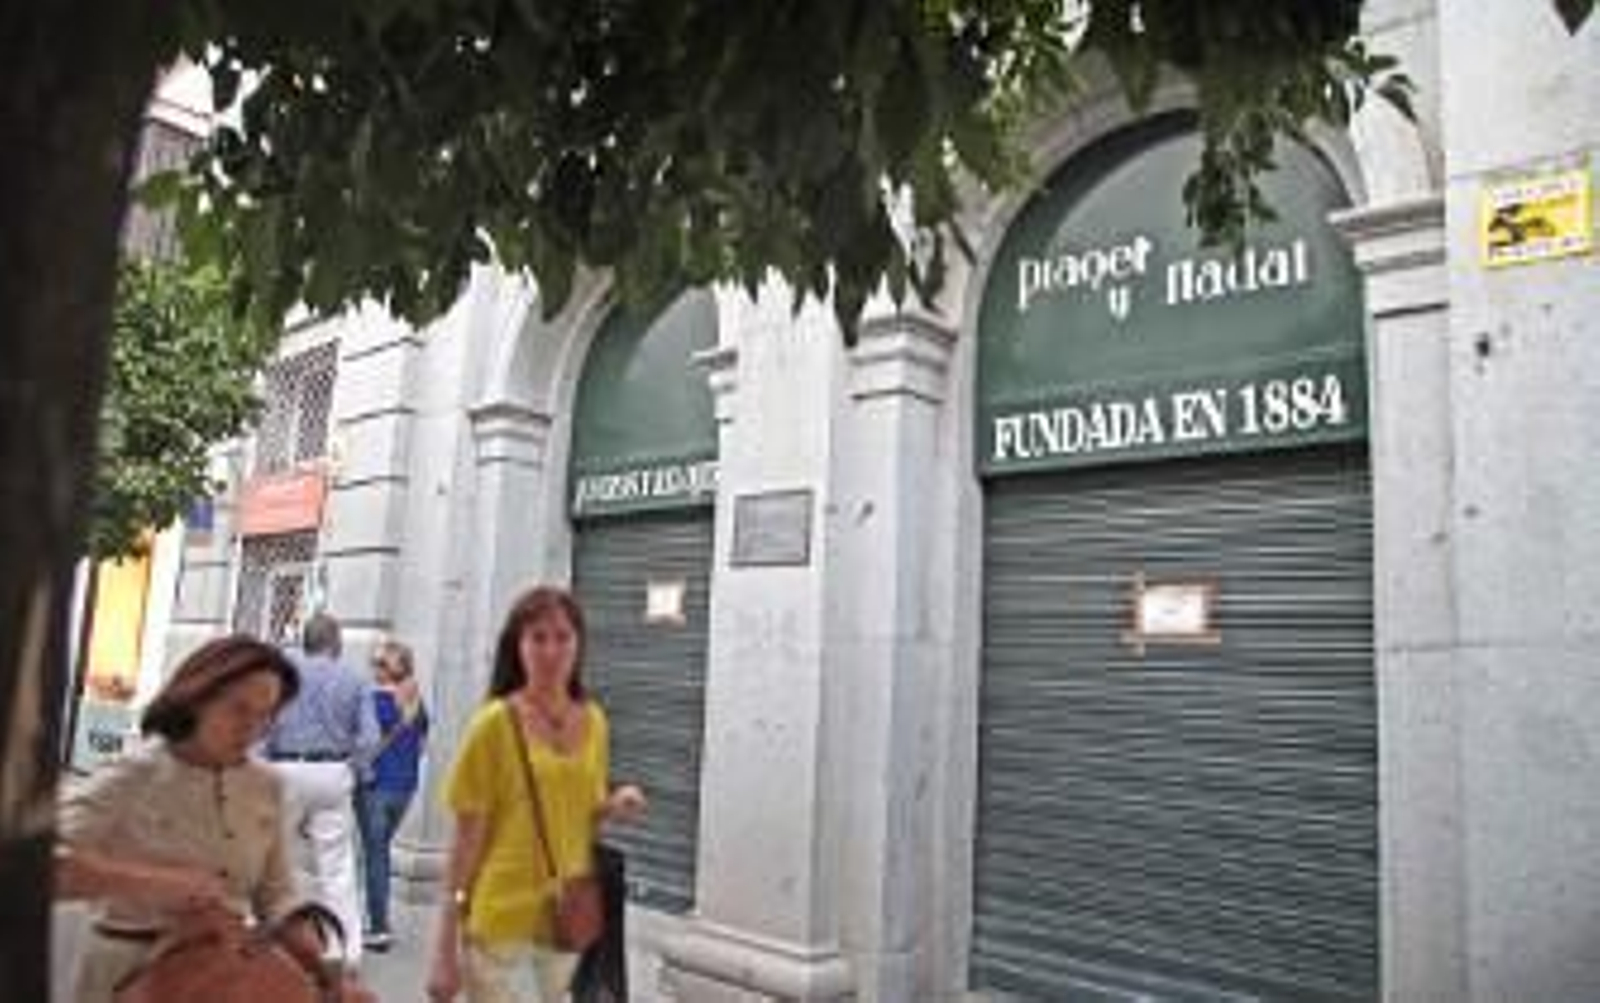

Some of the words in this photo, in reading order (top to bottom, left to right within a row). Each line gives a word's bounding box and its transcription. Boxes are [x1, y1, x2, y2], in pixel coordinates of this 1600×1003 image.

[993, 393, 1165, 460] FUNDADA
[1172, 388, 1227, 440] EN
[1238, 373, 1348, 435] 1884
